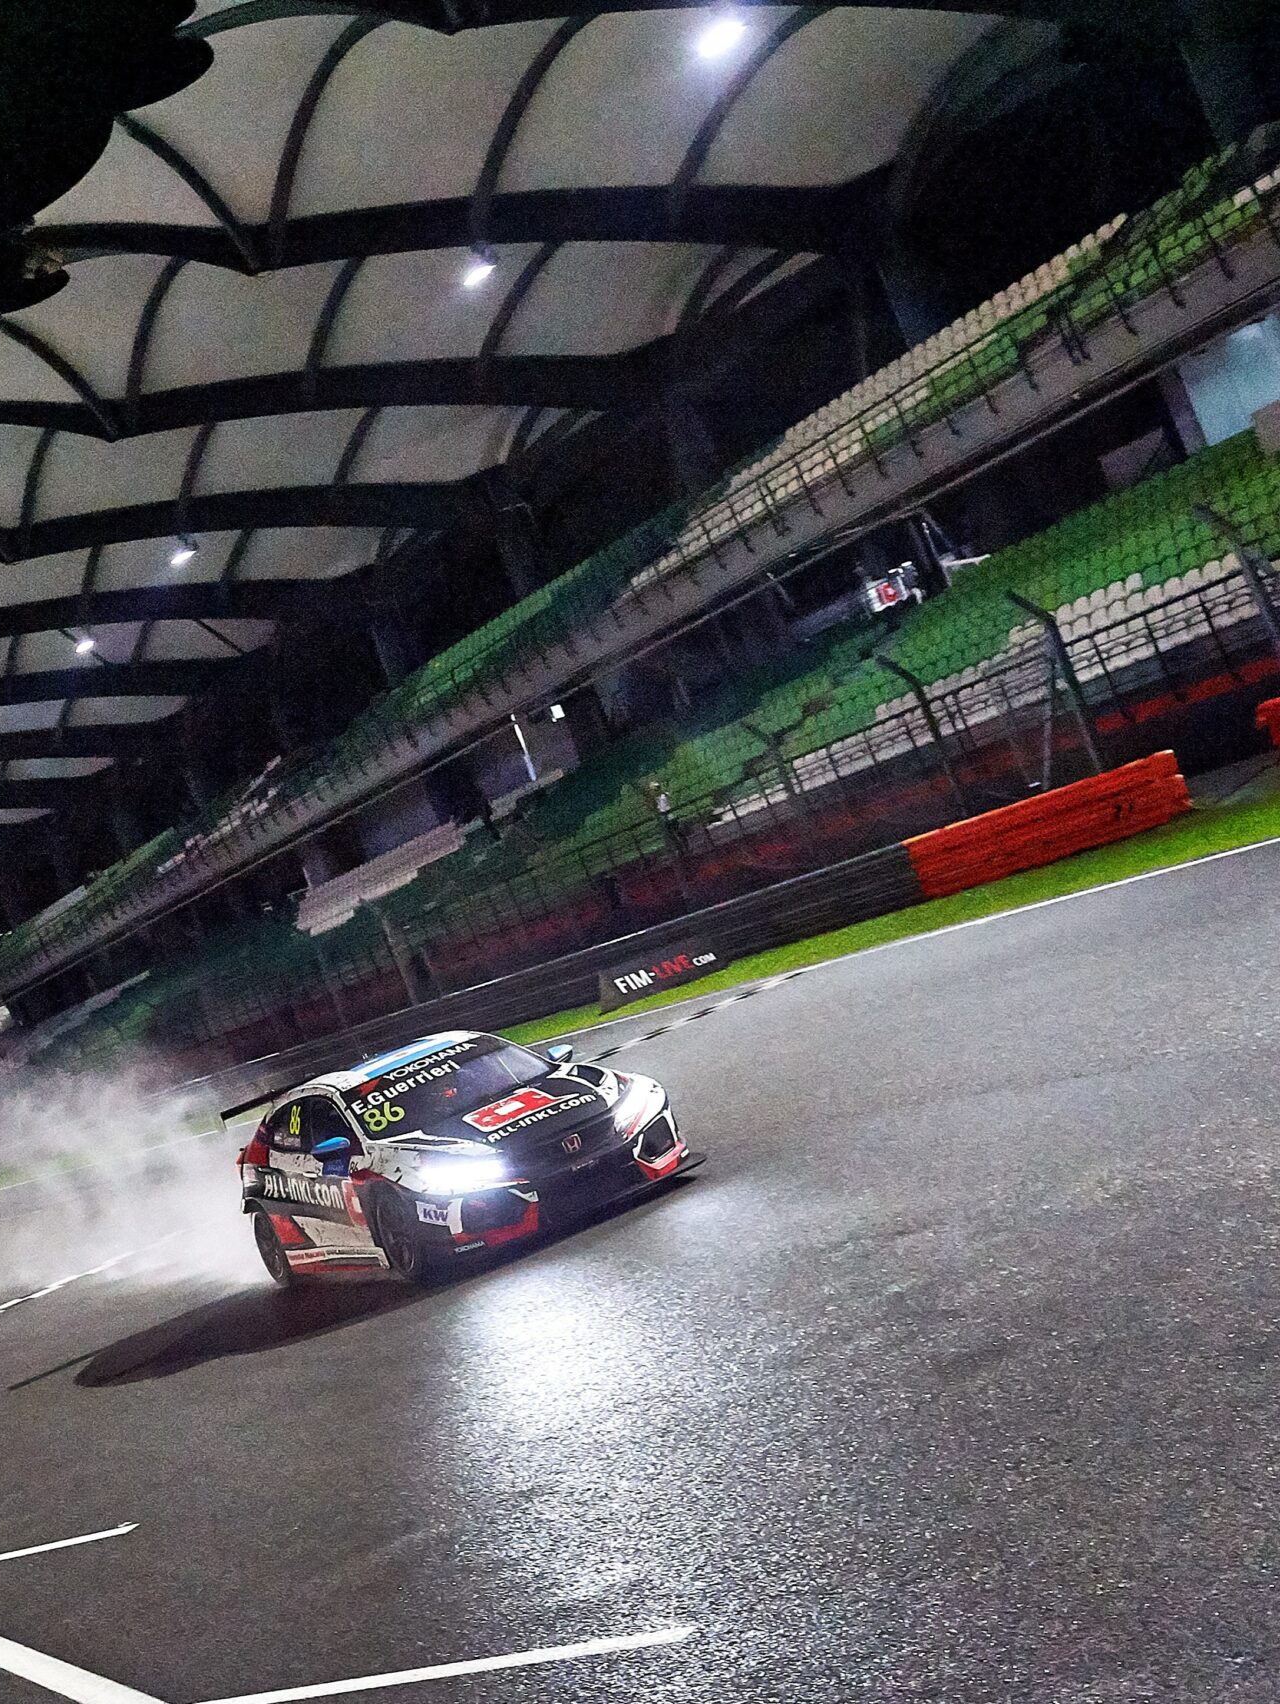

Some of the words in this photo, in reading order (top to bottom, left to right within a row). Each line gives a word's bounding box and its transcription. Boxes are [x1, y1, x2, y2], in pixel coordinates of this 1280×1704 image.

[382, 1042, 478, 1081] YOKOHAMA
[350, 1059, 461, 1115] E.Guerrieri
[289, 1104, 301, 1135] 86
[363, 1101, 406, 1132] 86
[423, 1208, 448, 1222] KW
[453, 1240, 486, 1253] YOKOHAMA
